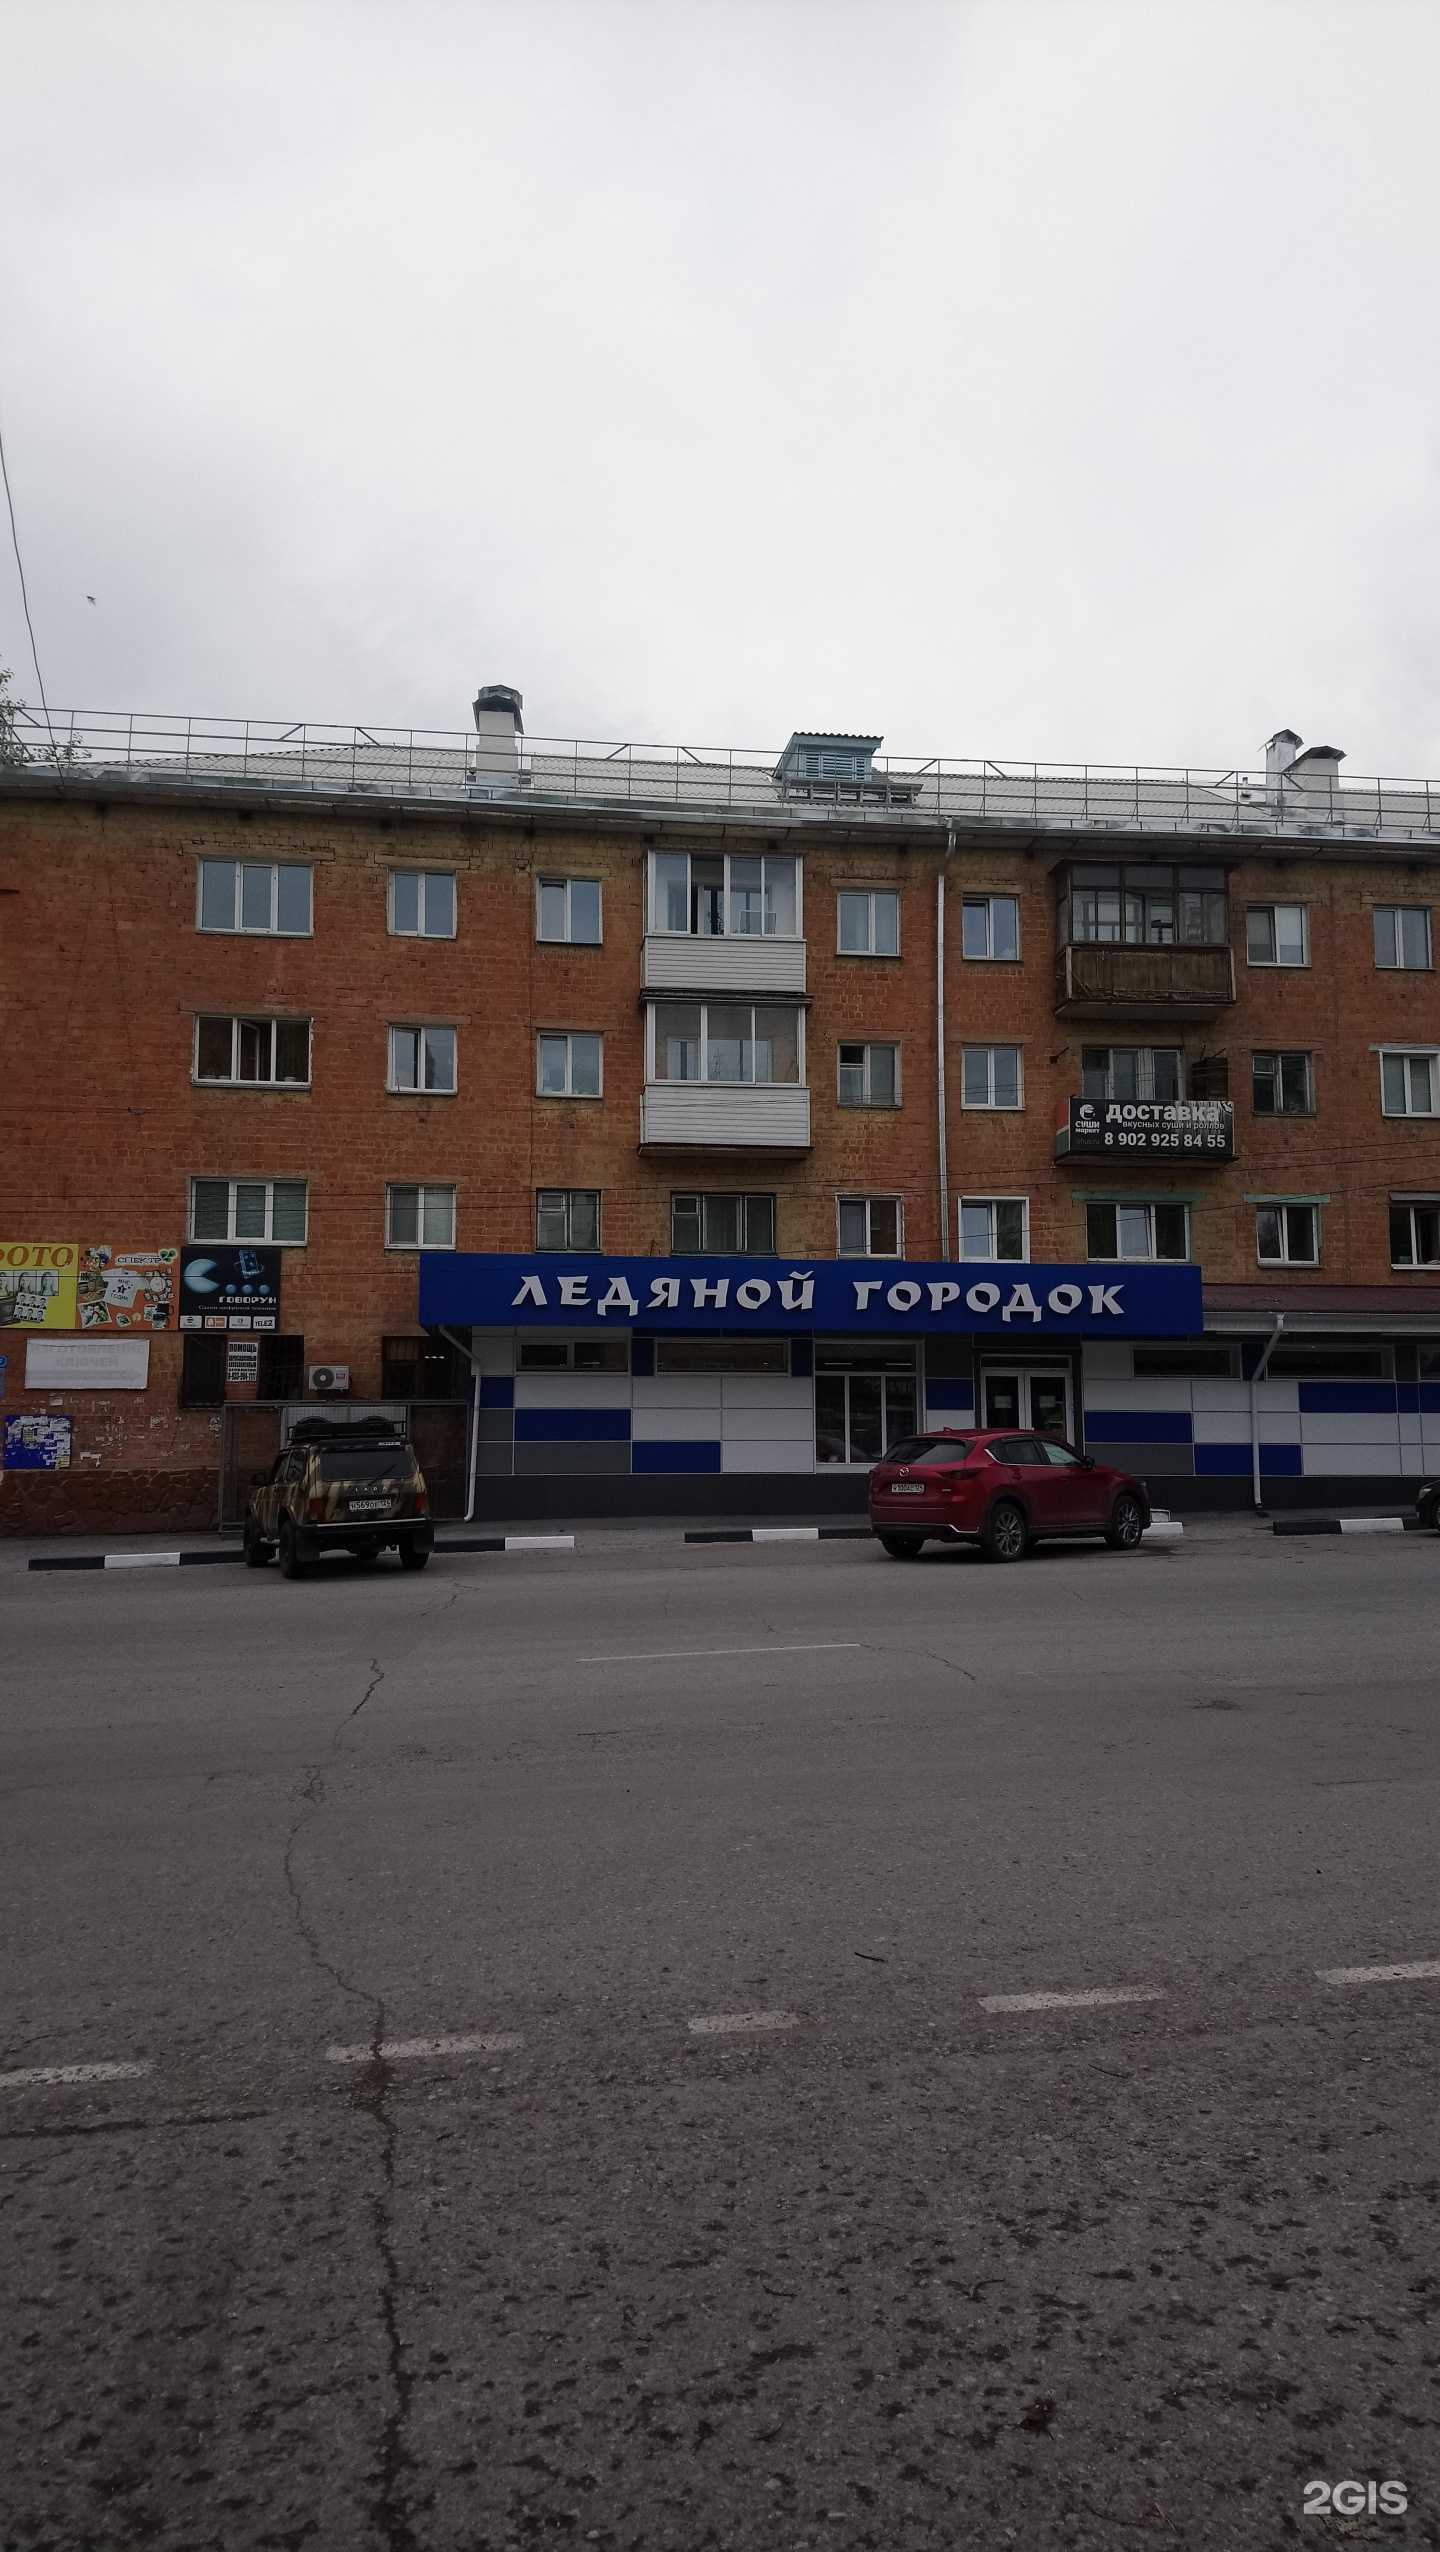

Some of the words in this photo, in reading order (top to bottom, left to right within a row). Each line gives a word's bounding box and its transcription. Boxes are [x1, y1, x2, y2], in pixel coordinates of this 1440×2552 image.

[1122, 1121, 1160, 1130] вкусных
[1161, 1121, 1184, 1130] суши
[1193, 1122, 1225, 1131] роллов
[1104, 1132, 1114, 1146] 8
[1118, 1132, 1147, 1147] 902
[1151, 1133, 1180, 1147] 925
[1183, 1134, 1202, 1148] 84
[1207, 1134, 1226, 1148] 55
[0, 1245, 74, 1267] ОТО
[218, 1296, 277, 1304] ГОВОРУН
[511, 1270, 815, 1316] ЛЕДЯНОЙ
[852, 1280, 1126, 1322] ГОРОДОК
[230, 1343, 257, 1353] ПОМОЩЬ
